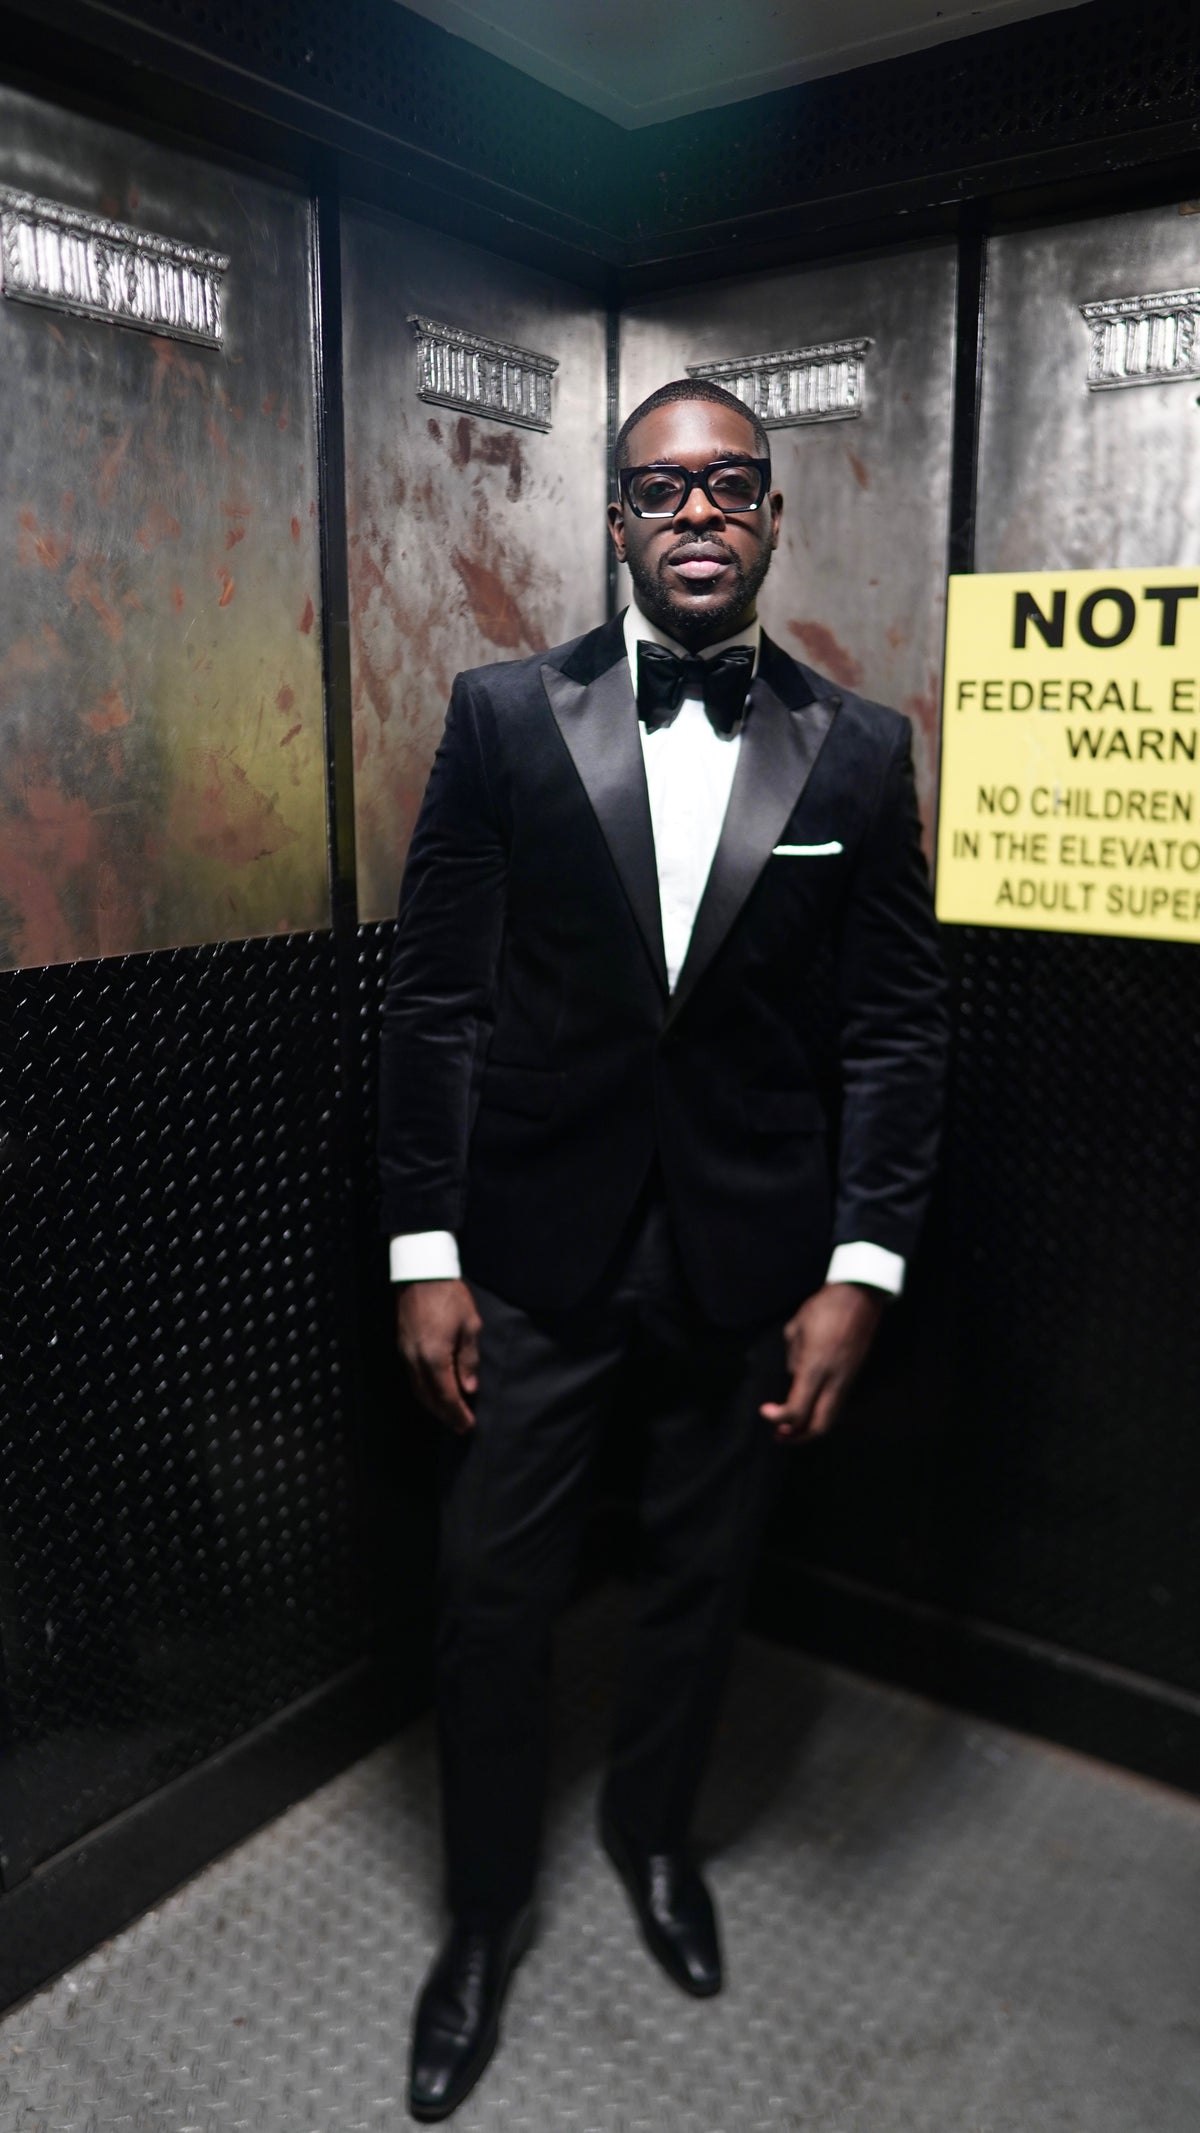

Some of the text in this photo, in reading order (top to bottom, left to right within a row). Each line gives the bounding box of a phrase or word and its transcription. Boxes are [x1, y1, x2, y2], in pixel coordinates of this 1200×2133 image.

[1011, 586, 1199, 649] NOT
[956, 679, 1200, 713] FEDERAL E
[1066, 728, 1198, 762] WARN
[978, 786, 1193, 822] NO CHILDREN
[954, 832, 1200, 873] IN THE ELEVATO
[996, 880, 1095, 913] ADULT
